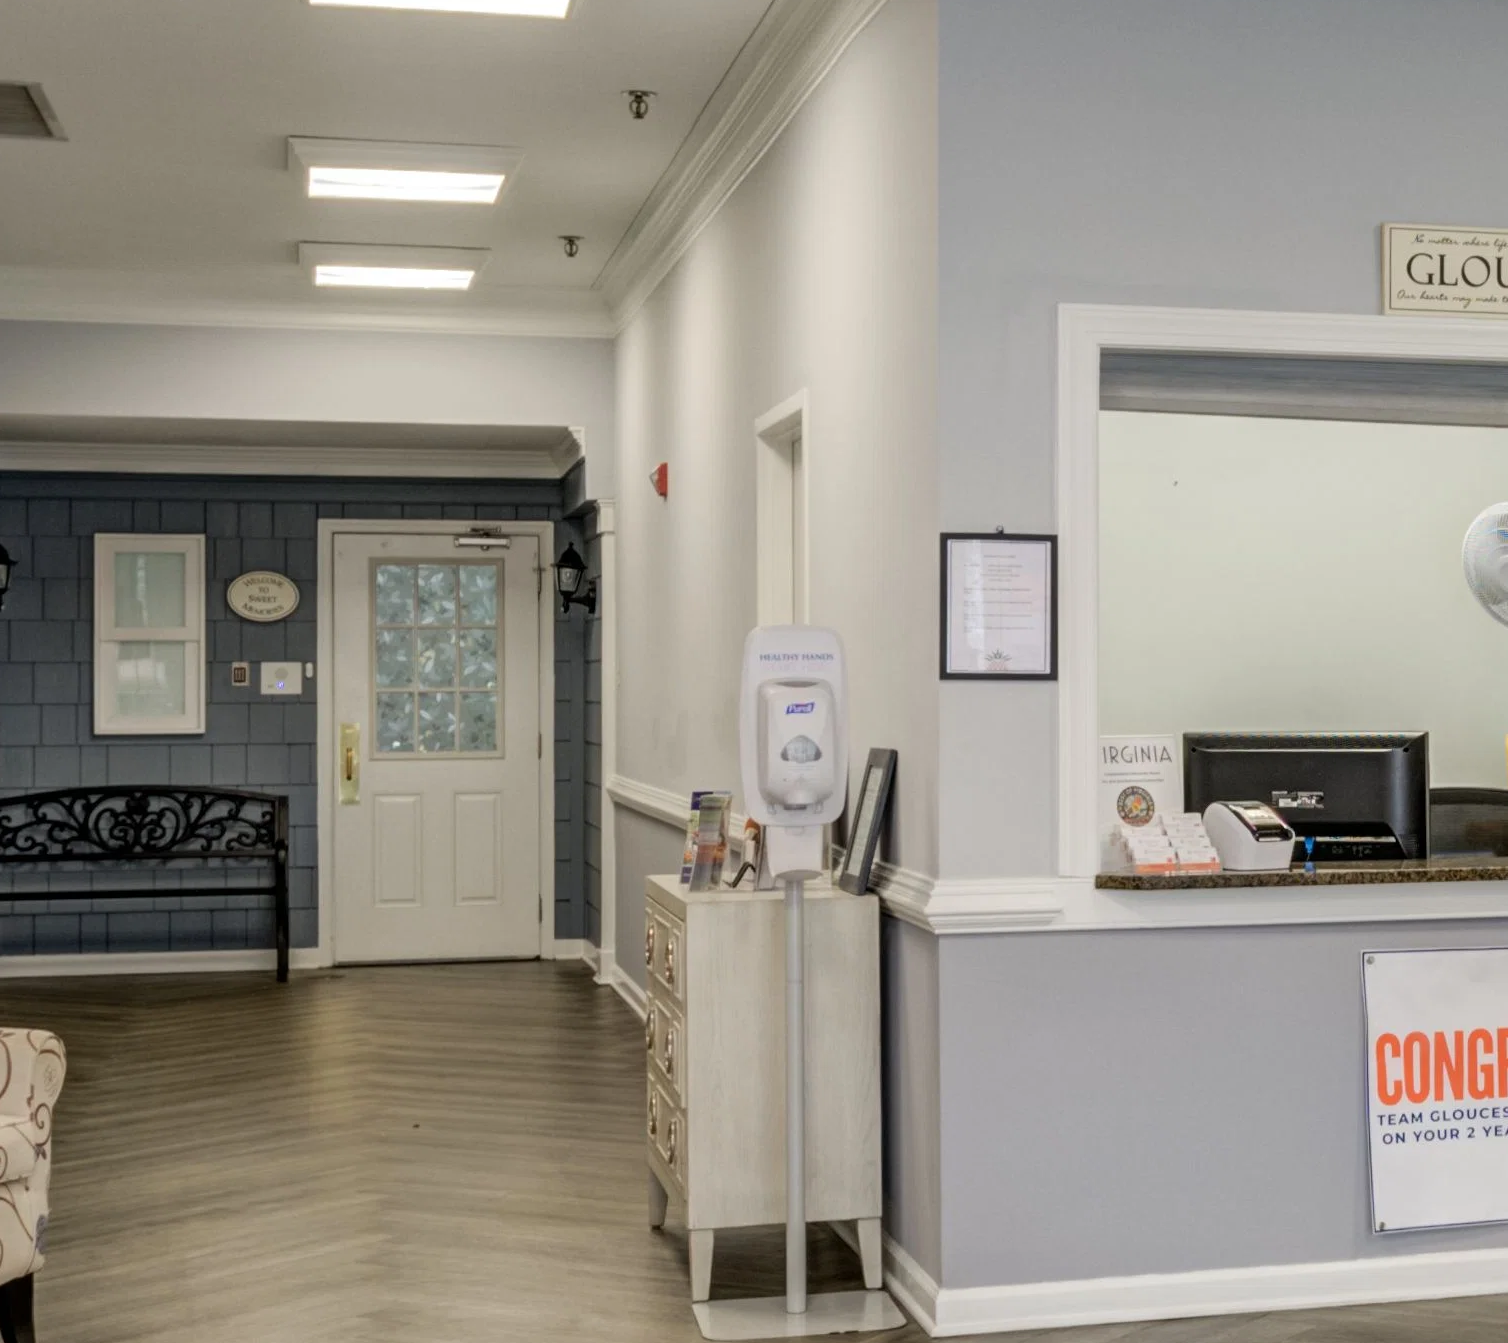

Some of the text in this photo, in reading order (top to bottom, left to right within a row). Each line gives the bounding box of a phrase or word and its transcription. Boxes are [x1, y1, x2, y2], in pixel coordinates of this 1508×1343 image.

[1493, 238, 1508, 252] life
[1397, 289, 1415, 299] Our
[1420, 290, 1448, 301] hearts
[1453, 296, 1471, 309] may
[1102, 745, 1173, 764] IRGINIA
[1377, 1111, 1423, 1126] TEAM
[1382, 1131, 1406, 1145] ON
[1413, 1127, 1460, 1143] YOUR
[1467, 1126, 1476, 1139] 2
